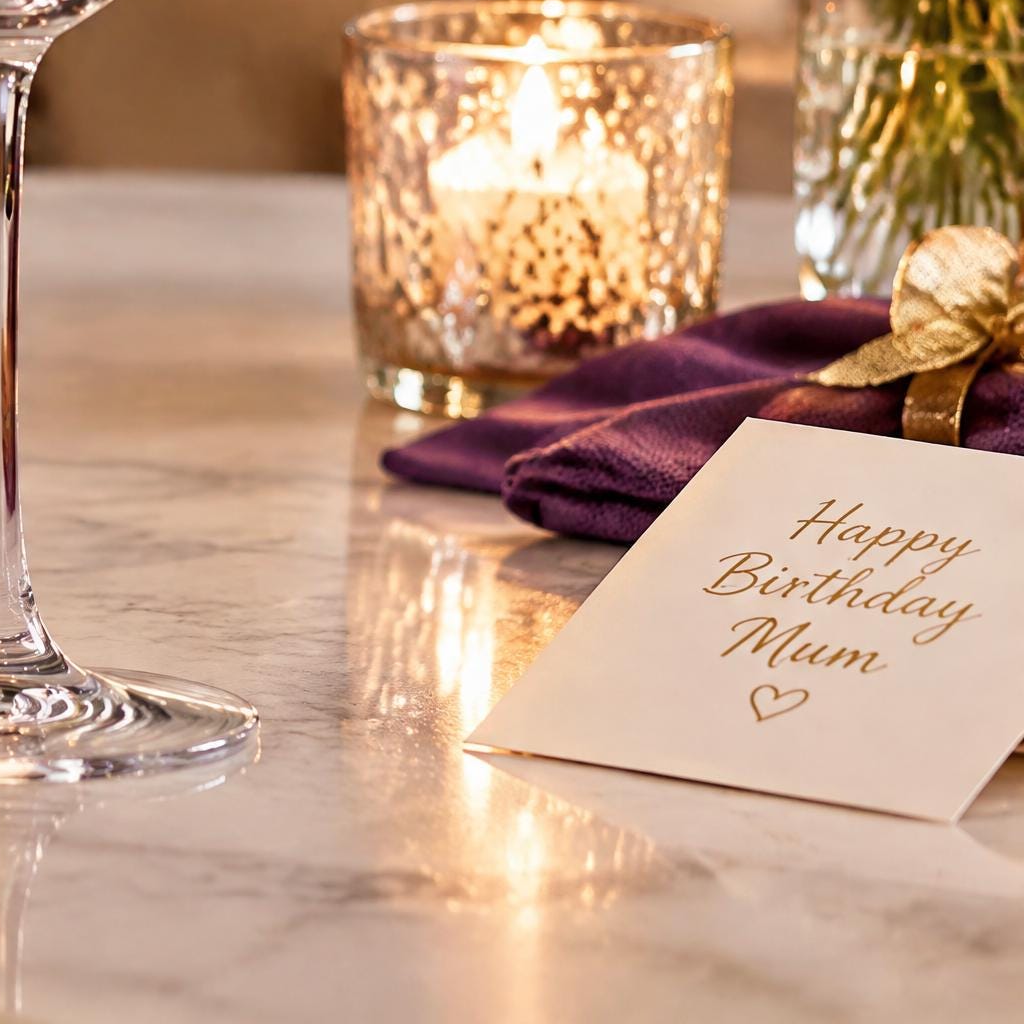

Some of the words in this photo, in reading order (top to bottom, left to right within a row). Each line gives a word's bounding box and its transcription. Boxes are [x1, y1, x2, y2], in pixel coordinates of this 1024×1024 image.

[788, 498, 982, 576] Happy
[702, 551, 983, 646] Birthday
[719, 616, 888, 674] Mum
